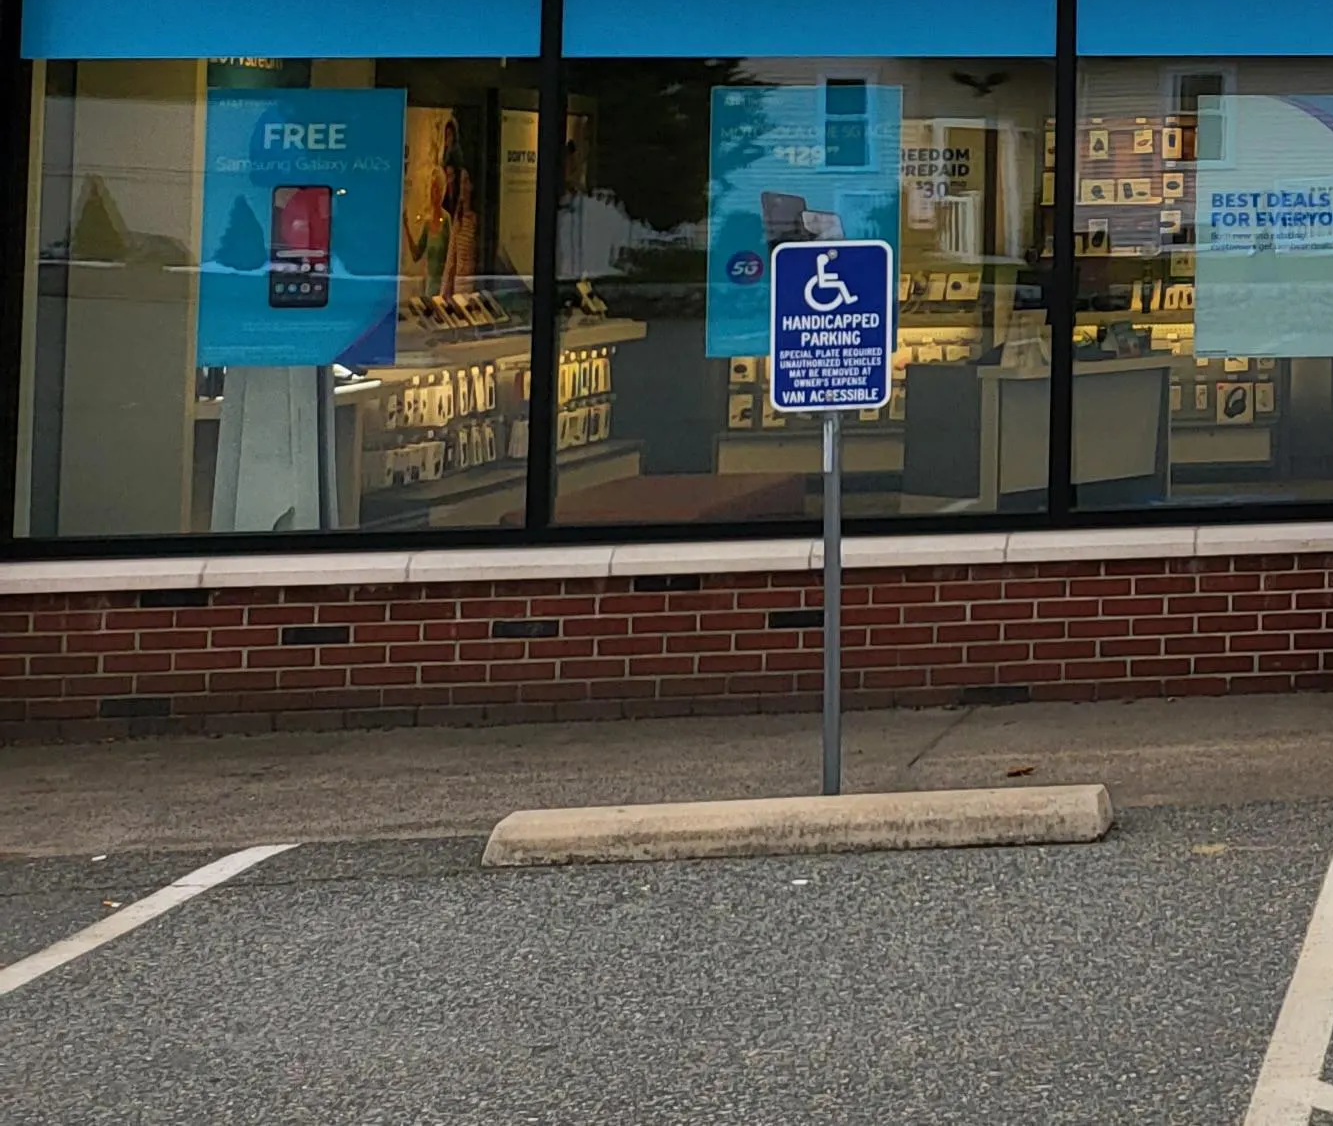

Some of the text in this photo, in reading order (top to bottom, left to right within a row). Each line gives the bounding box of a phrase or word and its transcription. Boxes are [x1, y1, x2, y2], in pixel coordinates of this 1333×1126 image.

[264, 123, 347, 150] FREE
[215, 156, 291, 173] Samsung
[295, 155, 348, 173] Galaxy
[1211, 192, 1331, 208] BEST DEALS
[1211, 212, 1251, 227] FOR
[731, 260, 759, 276] 5G
[782, 313, 880, 331] HANDICAPPED
[800, 330, 861, 347] PARKING
[780, 347, 883, 359] SPECIAL PLATE REQUIRED
[780, 356, 882, 369] UNAUTHORIZED VEHICLES
[789, 366, 872, 378] MAY BE REMOVED AT
[793, 376, 868, 388] OWNER'S EXPENSE
[782, 391, 806, 404] VAN
